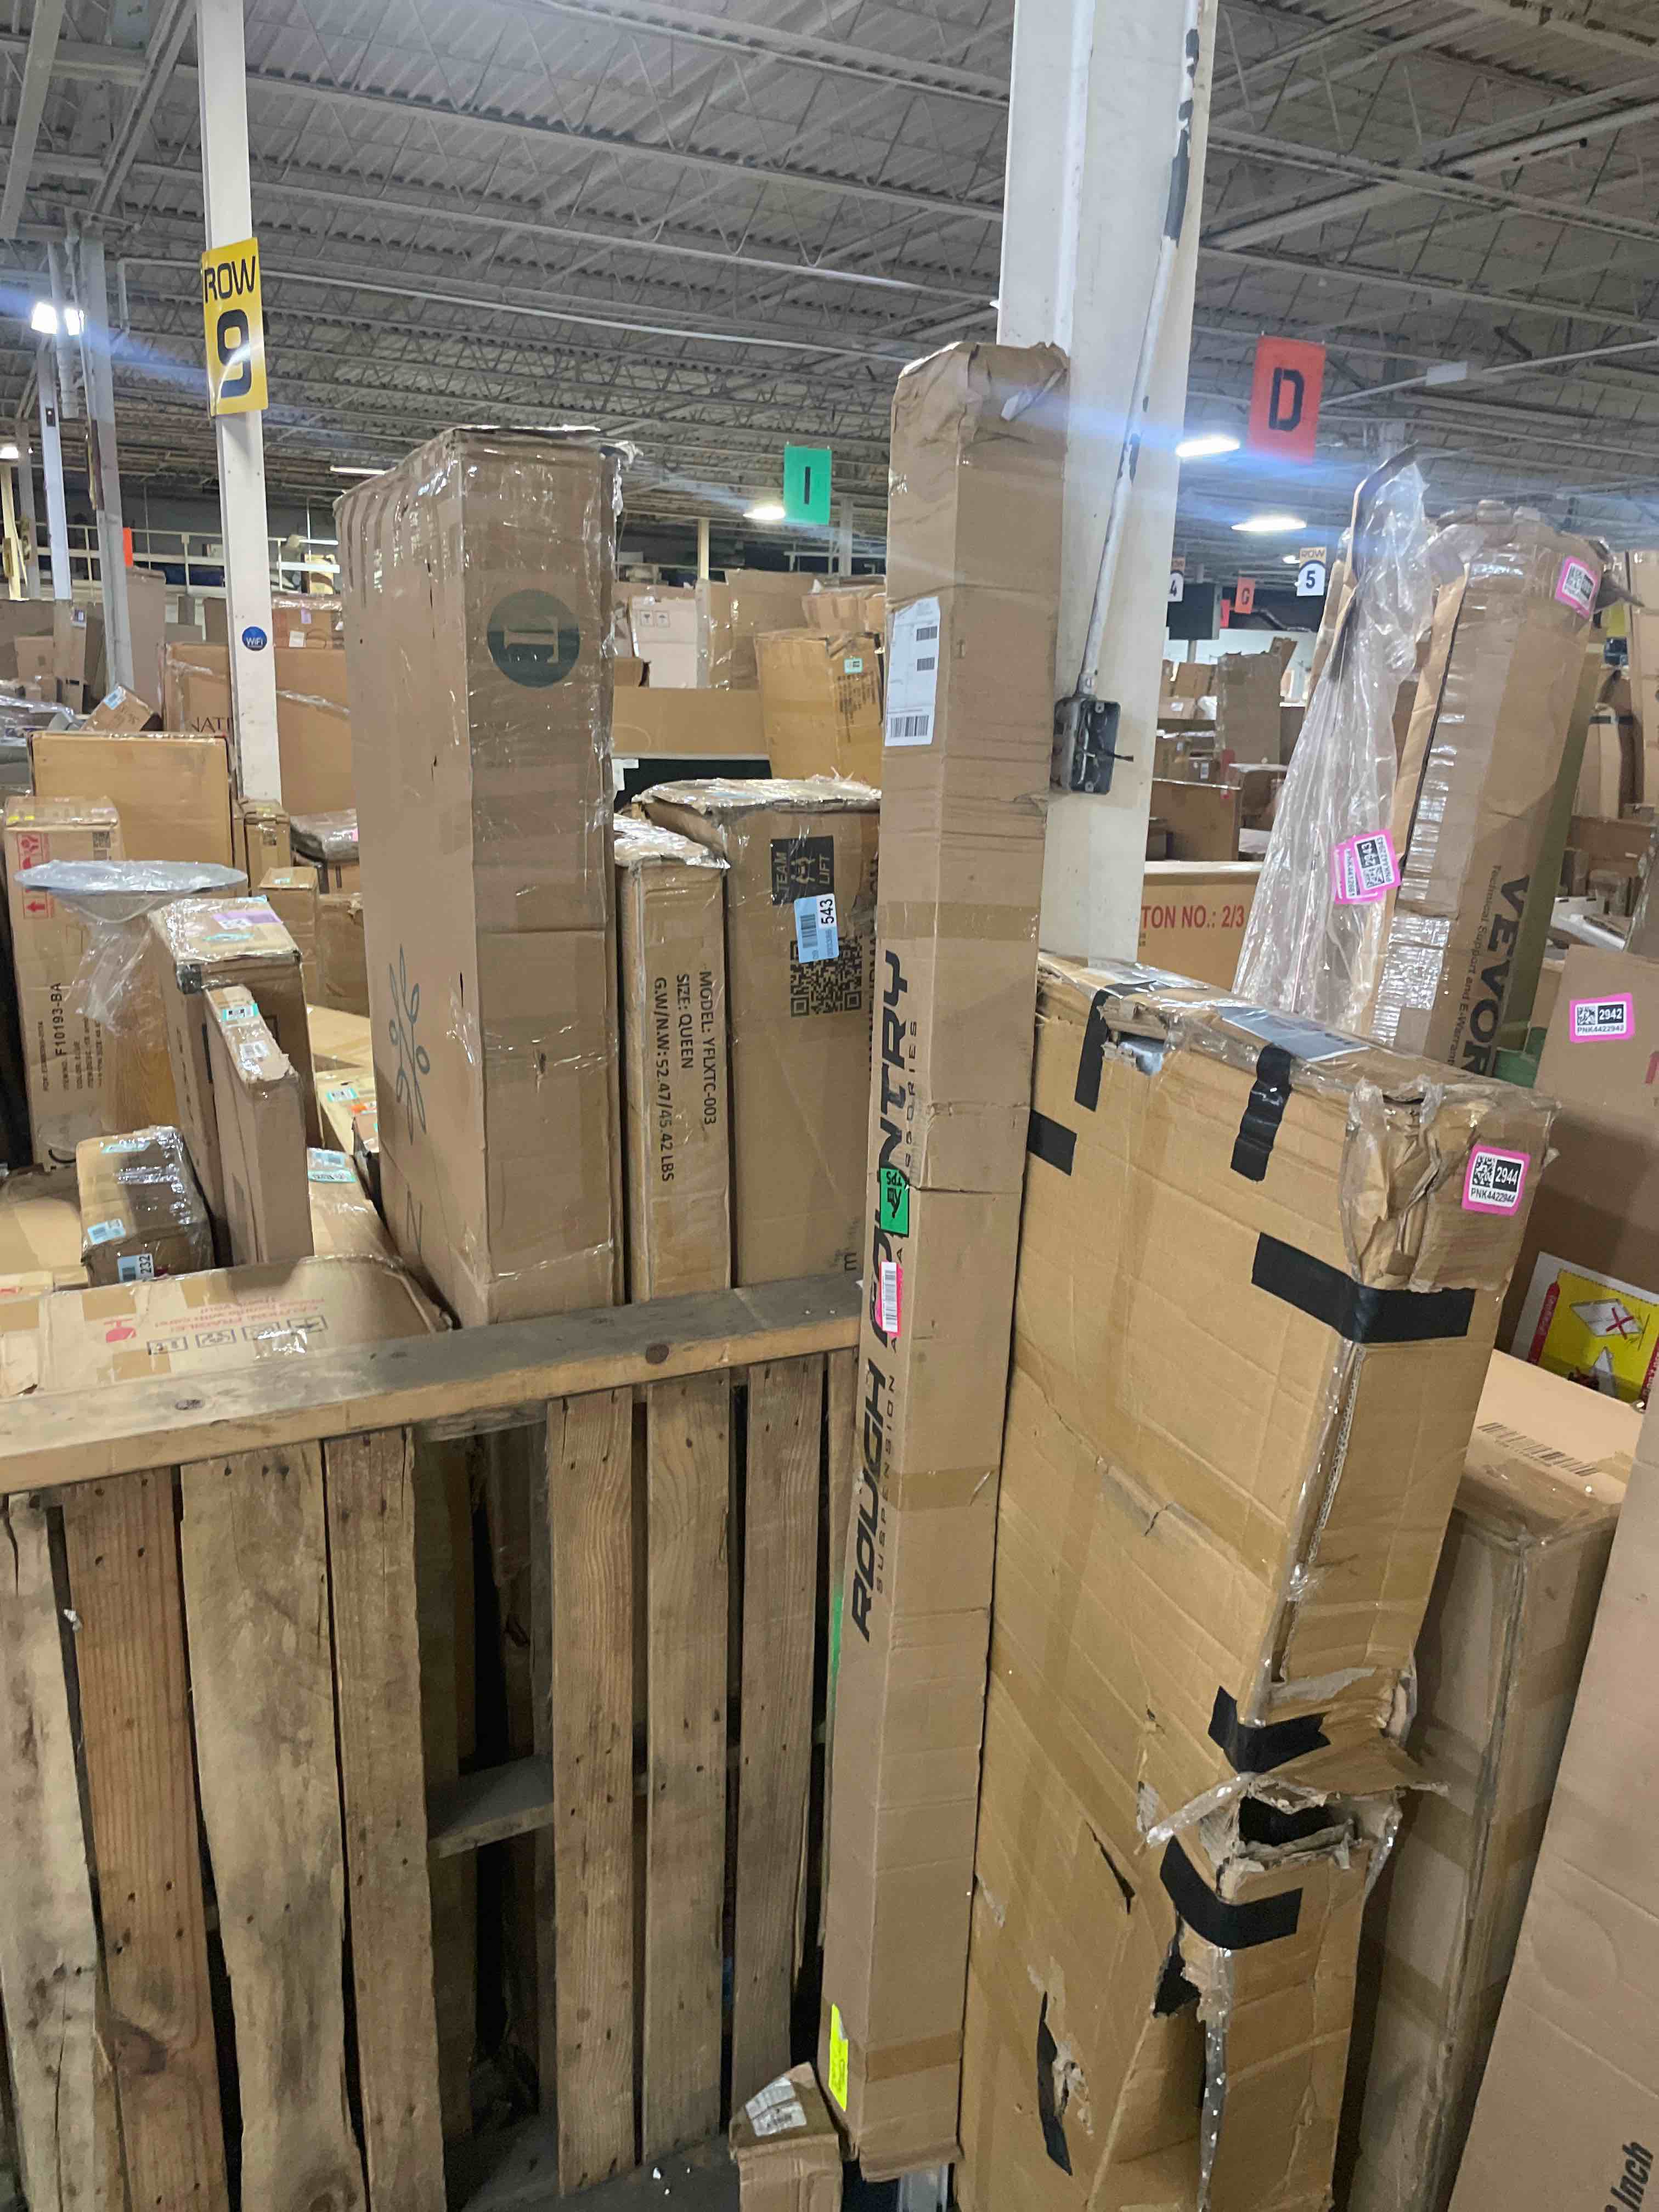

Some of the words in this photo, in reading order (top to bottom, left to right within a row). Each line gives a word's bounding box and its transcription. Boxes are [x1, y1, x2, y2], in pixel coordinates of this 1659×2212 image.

[204, 256, 256, 303] ROW
[217, 308, 252, 399] 9
[1268, 367, 1305, 432] D
[1300, 549, 1324, 558] ROW
[1306, 570, 1316, 589] 5
[774, 851, 788, 893] TEAM
[818, 854, 831, 885] LIFT
[819, 899, 834, 924] 543
[1481, 865, 1502, 923] Technical
[1221, 905, 1245, 929] 2/3
[1468, 925, 1487, 974] Support
[676, 974, 691, 1010] SIZE:
[1460, 873, 1530, 1077] VEVOR
[1462, 977, 1474, 1001] and
[50, 983, 67, 1056] F10193-BA
[698, 970, 713, 1034] MODEL:
[1599, 1008, 1623, 1021] 2942
[678, 1013, 693, 1069] QUEEN
[1577, 1025, 1624, 1034] PNK4422942
[703, 1037, 716, 1125] YFLXTC-003
[661, 1155, 675, 1182] LBS
[886, 1171, 902, 1187] TPS
[1495, 1166, 1519, 1186] 2944
[1470, 1187, 1516, 1203] PNK4422944
[139, 1255, 152, 1274] 232
[853, 1357, 886, 1642] ROUGH
[877, 1374, 895, 1593] SUSPENSION
[1610, 2141, 1654, 2212] Inch
